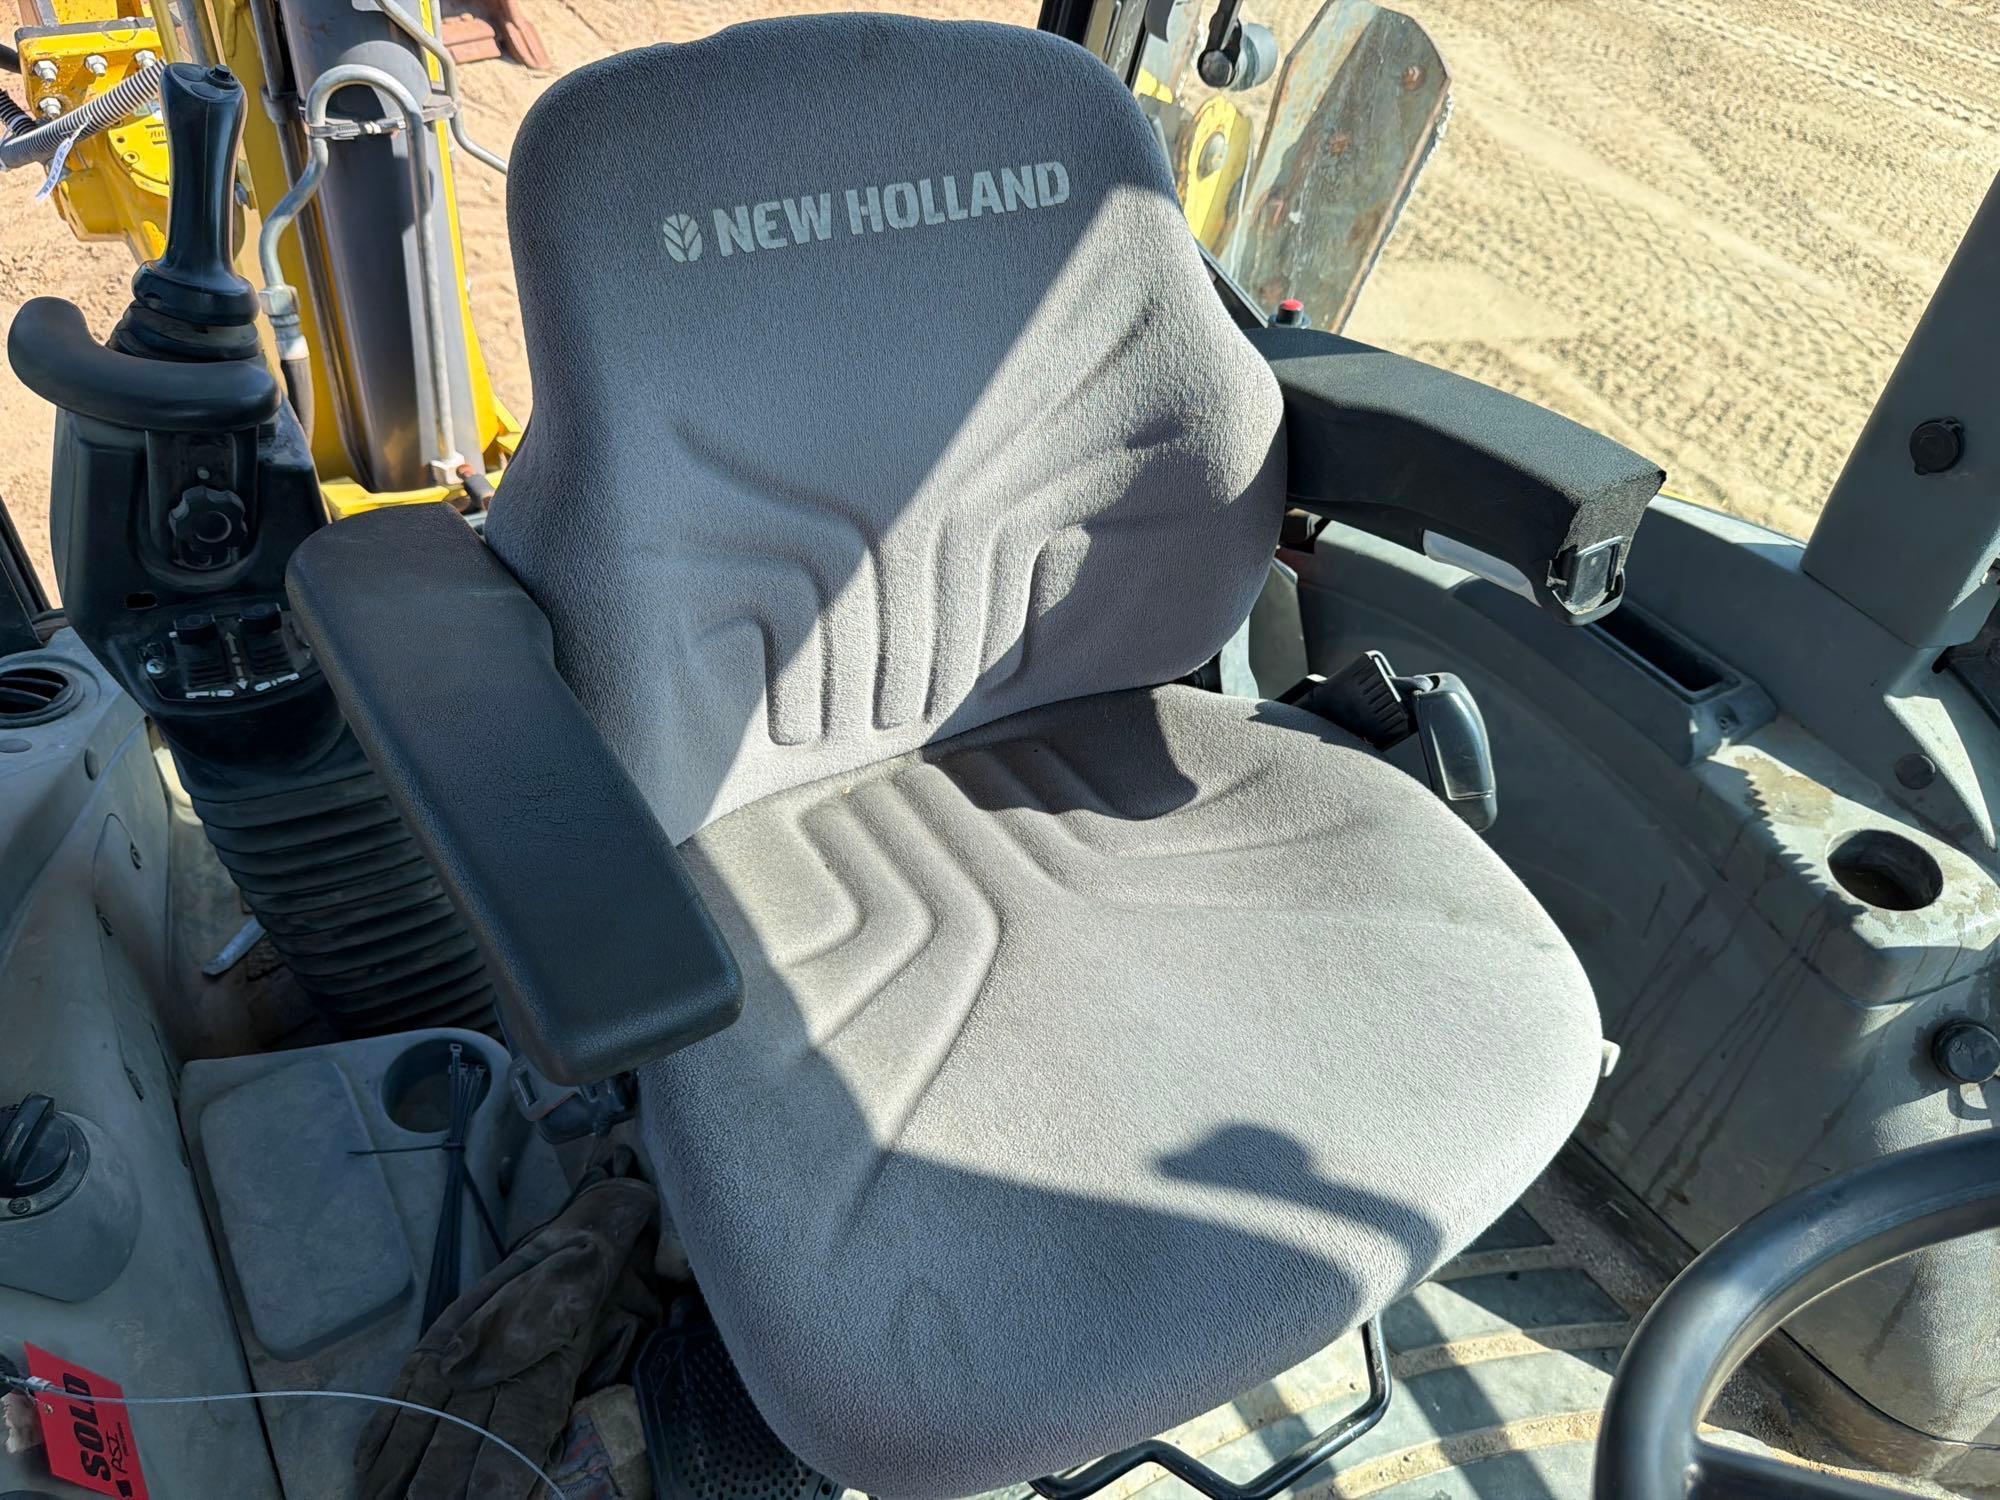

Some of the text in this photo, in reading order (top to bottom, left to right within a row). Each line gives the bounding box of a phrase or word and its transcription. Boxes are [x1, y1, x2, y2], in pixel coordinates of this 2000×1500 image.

[712, 161, 1070, 257] NEW HOLLAND
[63, 1373, 111, 1482] SOLD
